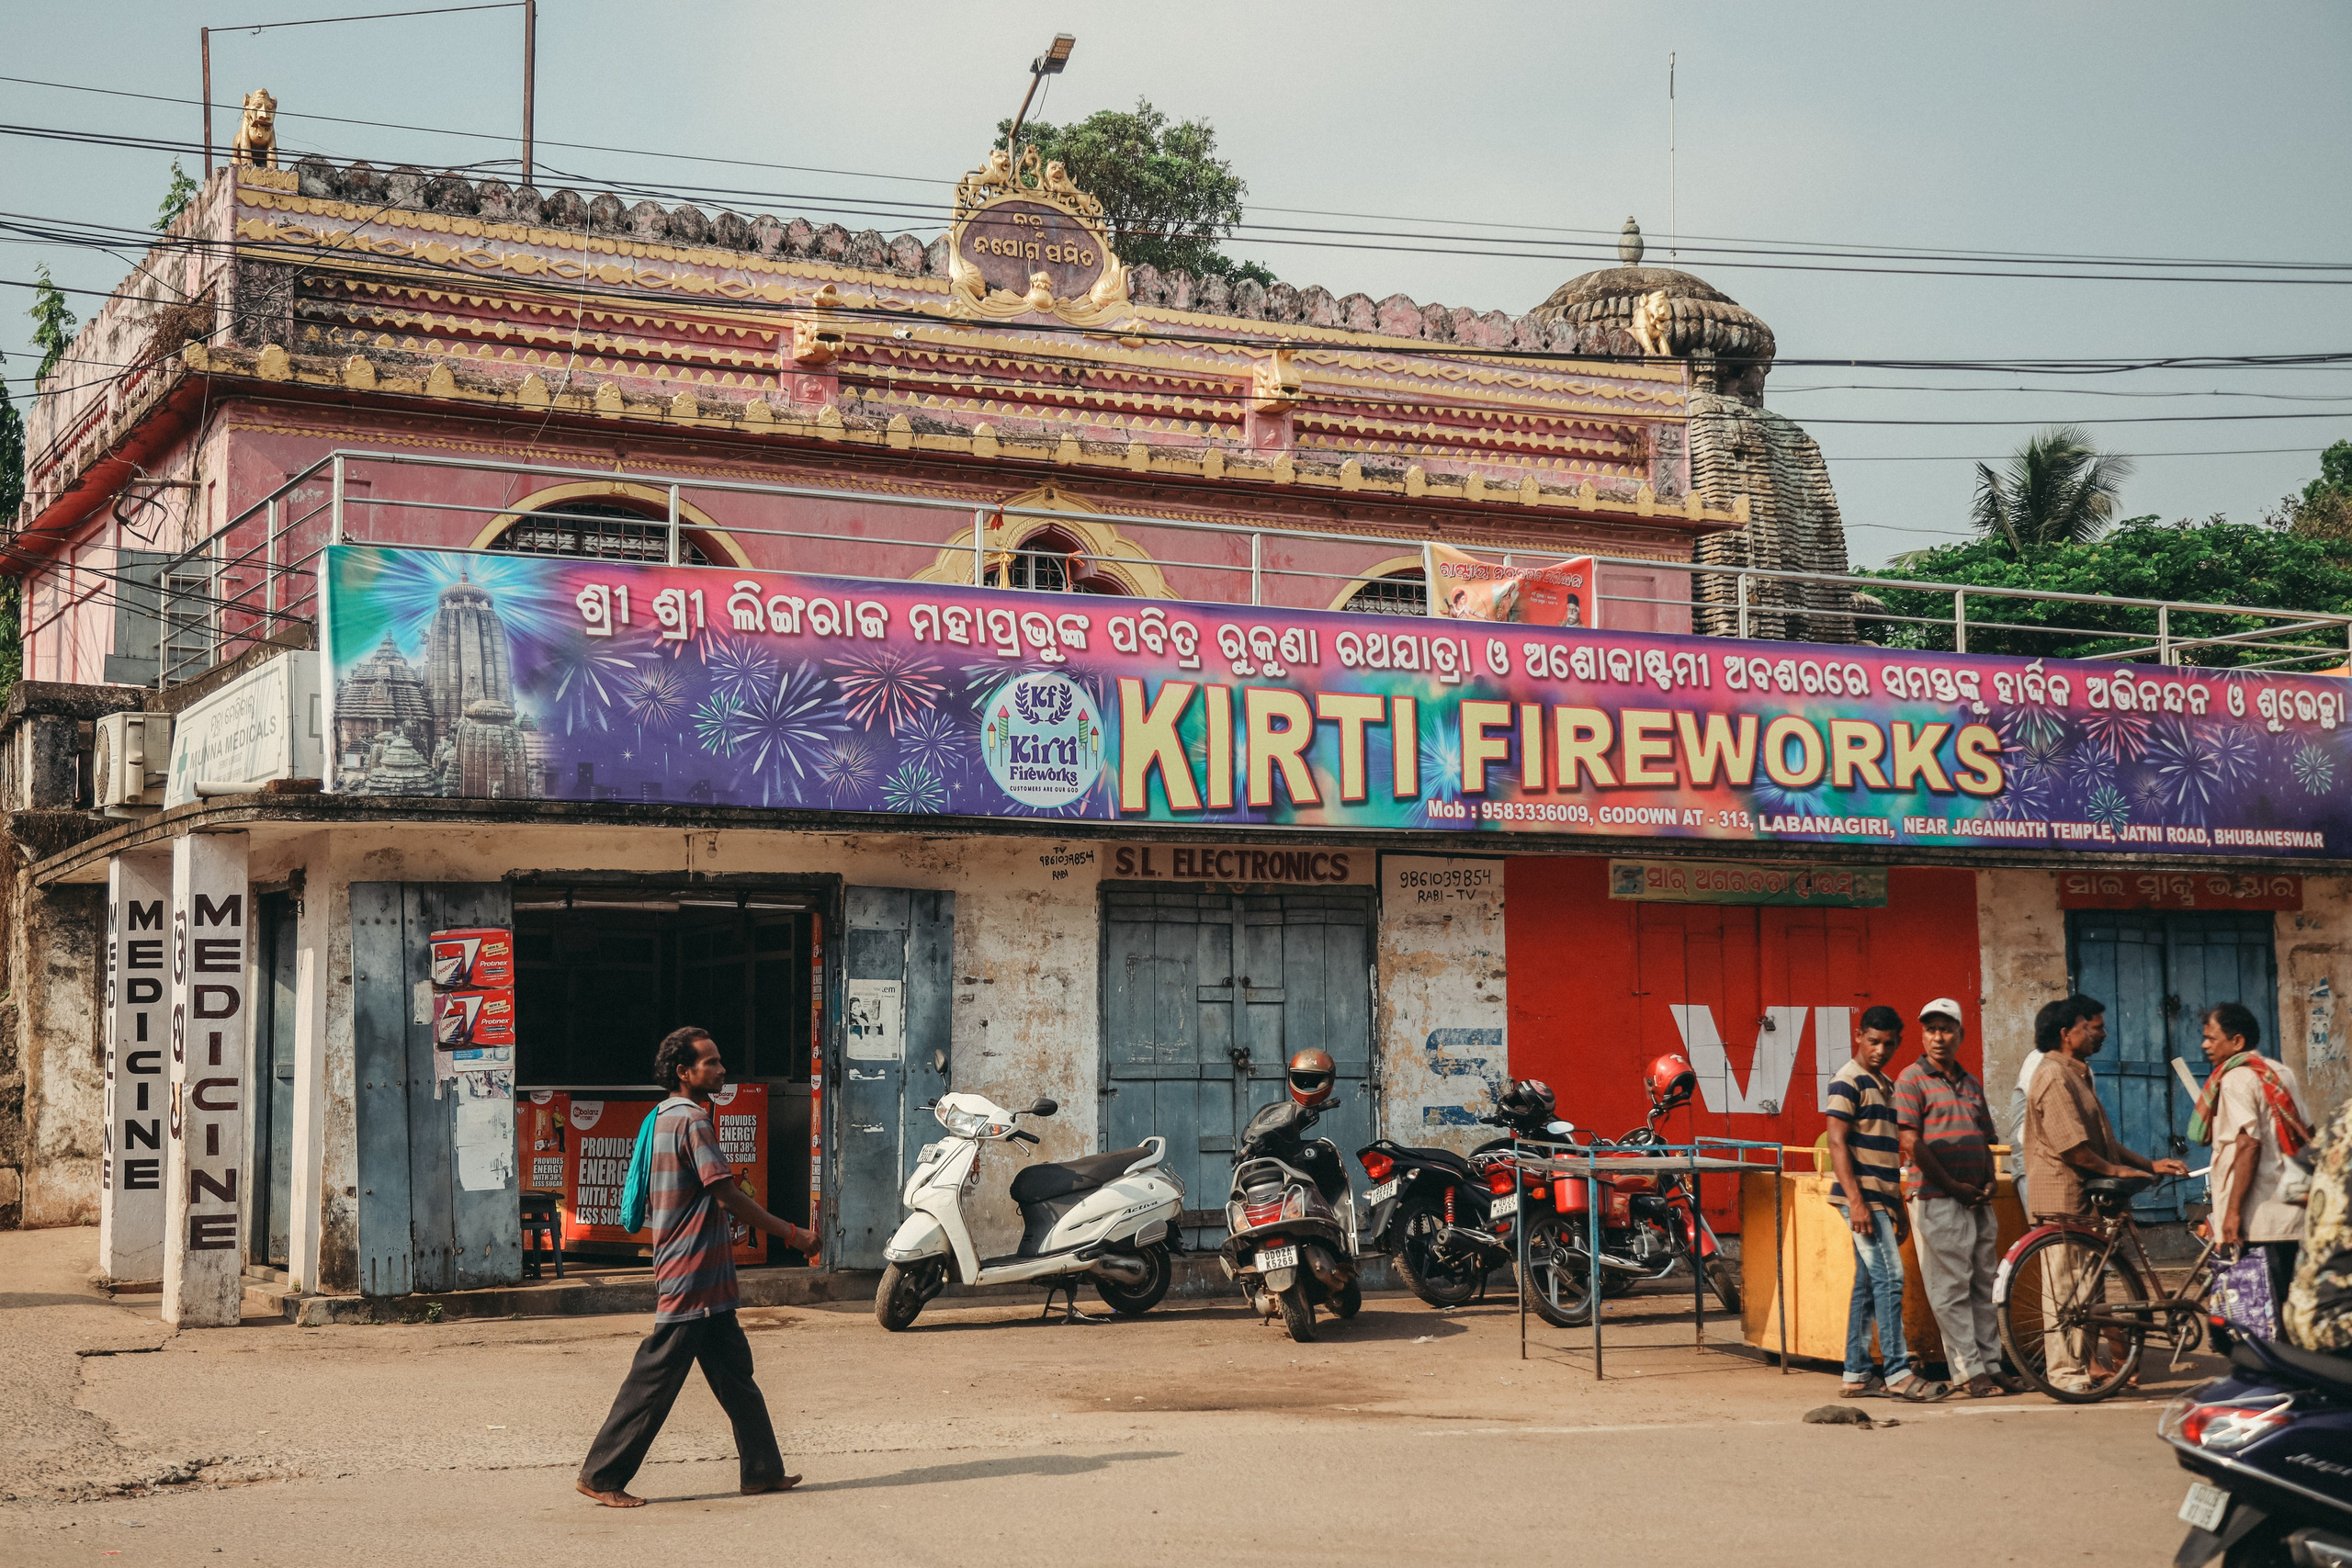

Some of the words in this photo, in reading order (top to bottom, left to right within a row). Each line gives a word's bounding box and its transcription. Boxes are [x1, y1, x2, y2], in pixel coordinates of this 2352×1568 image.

[575, 582, 630, 637] ଶ୍ରୀ
[651, 586, 706, 640] ଶ୍ରୀ
[726, 580, 889, 638] ଲିଙ୍ଗରାଜ
[909, 603, 1091, 663] ମହାପ୍ରଭୁଙ୍କ
[1107, 606, 1201, 669] ପବିତ୍ର
[1216, 623, 1319, 678] ରୁକୁଣା
[1335, 631, 1471, 683] ରଥଯାତ୍ରା
[1486, 637, 1510, 676] ଓ
[1522, 643, 1711, 691] ଅଶୋକାଷ୍ଟମୀ
[1723, 655, 1871, 697] ଅବଶରରେ
[1881, 664, 1991, 716] ସମସ୍ତଙ୍କୁ
[2086, 668, 2210, 715] ଅଭିନନ୍ଦନ
[2226, 682, 2245, 717] ଓ
[2256, 686, 2345, 733] ଶୁଭେଚ୍ଛା
[1031, 685, 1057, 708] Kf
[190, 739, 223, 770] MUNNA
[225, 715, 277, 755] MEDICALS
[1010, 735, 1079, 765] Kirti
[1116, 675, 1418, 812] KIRTI
[1459, 698, 2005, 795] FIREWORKS
[1010, 766, 1079, 786] Fireworks
[1428, 799, 1466, 818] Mob
[1481, 802, 1595, 826] 9583336009,
[1599, 806, 1677, 826] GODOWN
[1681, 809, 1703, 827] AT
[1718, 810, 1754, 831] 313,
[1759, 814, 1895, 840] LABANAGIRI,
[1904, 817, 1948, 836] NEAR
[1951, 818, 2047, 839] JAGANNATH
[2051, 822, 2117, 844] TEMPLE,
[2120, 824, 2164, 842] JATNI
[2165, 826, 2211, 847] ROAD,
[2214, 829, 2324, 848] BHUBANESWAR
[1053, 846, 1068, 854] TV
[1115, 846, 1163, 877] S.L.
[1172, 848, 1351, 882] ELECTRONICS
[1052, 869, 1069, 881] RABI
[1399, 869, 1491, 888] 9861039854
[1418, 889, 1443, 903] RABI
[1456, 888, 1476, 900] TV
[104, 901, 118, 1190] MEDICINE
[124, 899, 164, 1190] MEDICINE
[189, 894, 243, 1251] MEDICINE
[719, 1114, 757, 1126] PROVIDES
[719, 1126, 757, 1142] ENERGY
[719, 1142, 739, 1153] WITH
[740, 1141, 756, 1153] 38%
[735, 1153, 756, 1163] SUGAR
[533, 1164, 563, 1174] ENERGY
[578, 1158, 628, 1186] ENERG
[577, 1186, 607, 1206] WITH
[575, 1207, 599, 1225] LESS
[601, 1208, 623, 1225] SUG
[1121, 1201, 1159, 1216] Activa
[1265, 1247, 1292, 1260] OD02A
[1266, 1257, 1294, 1269] K5269
